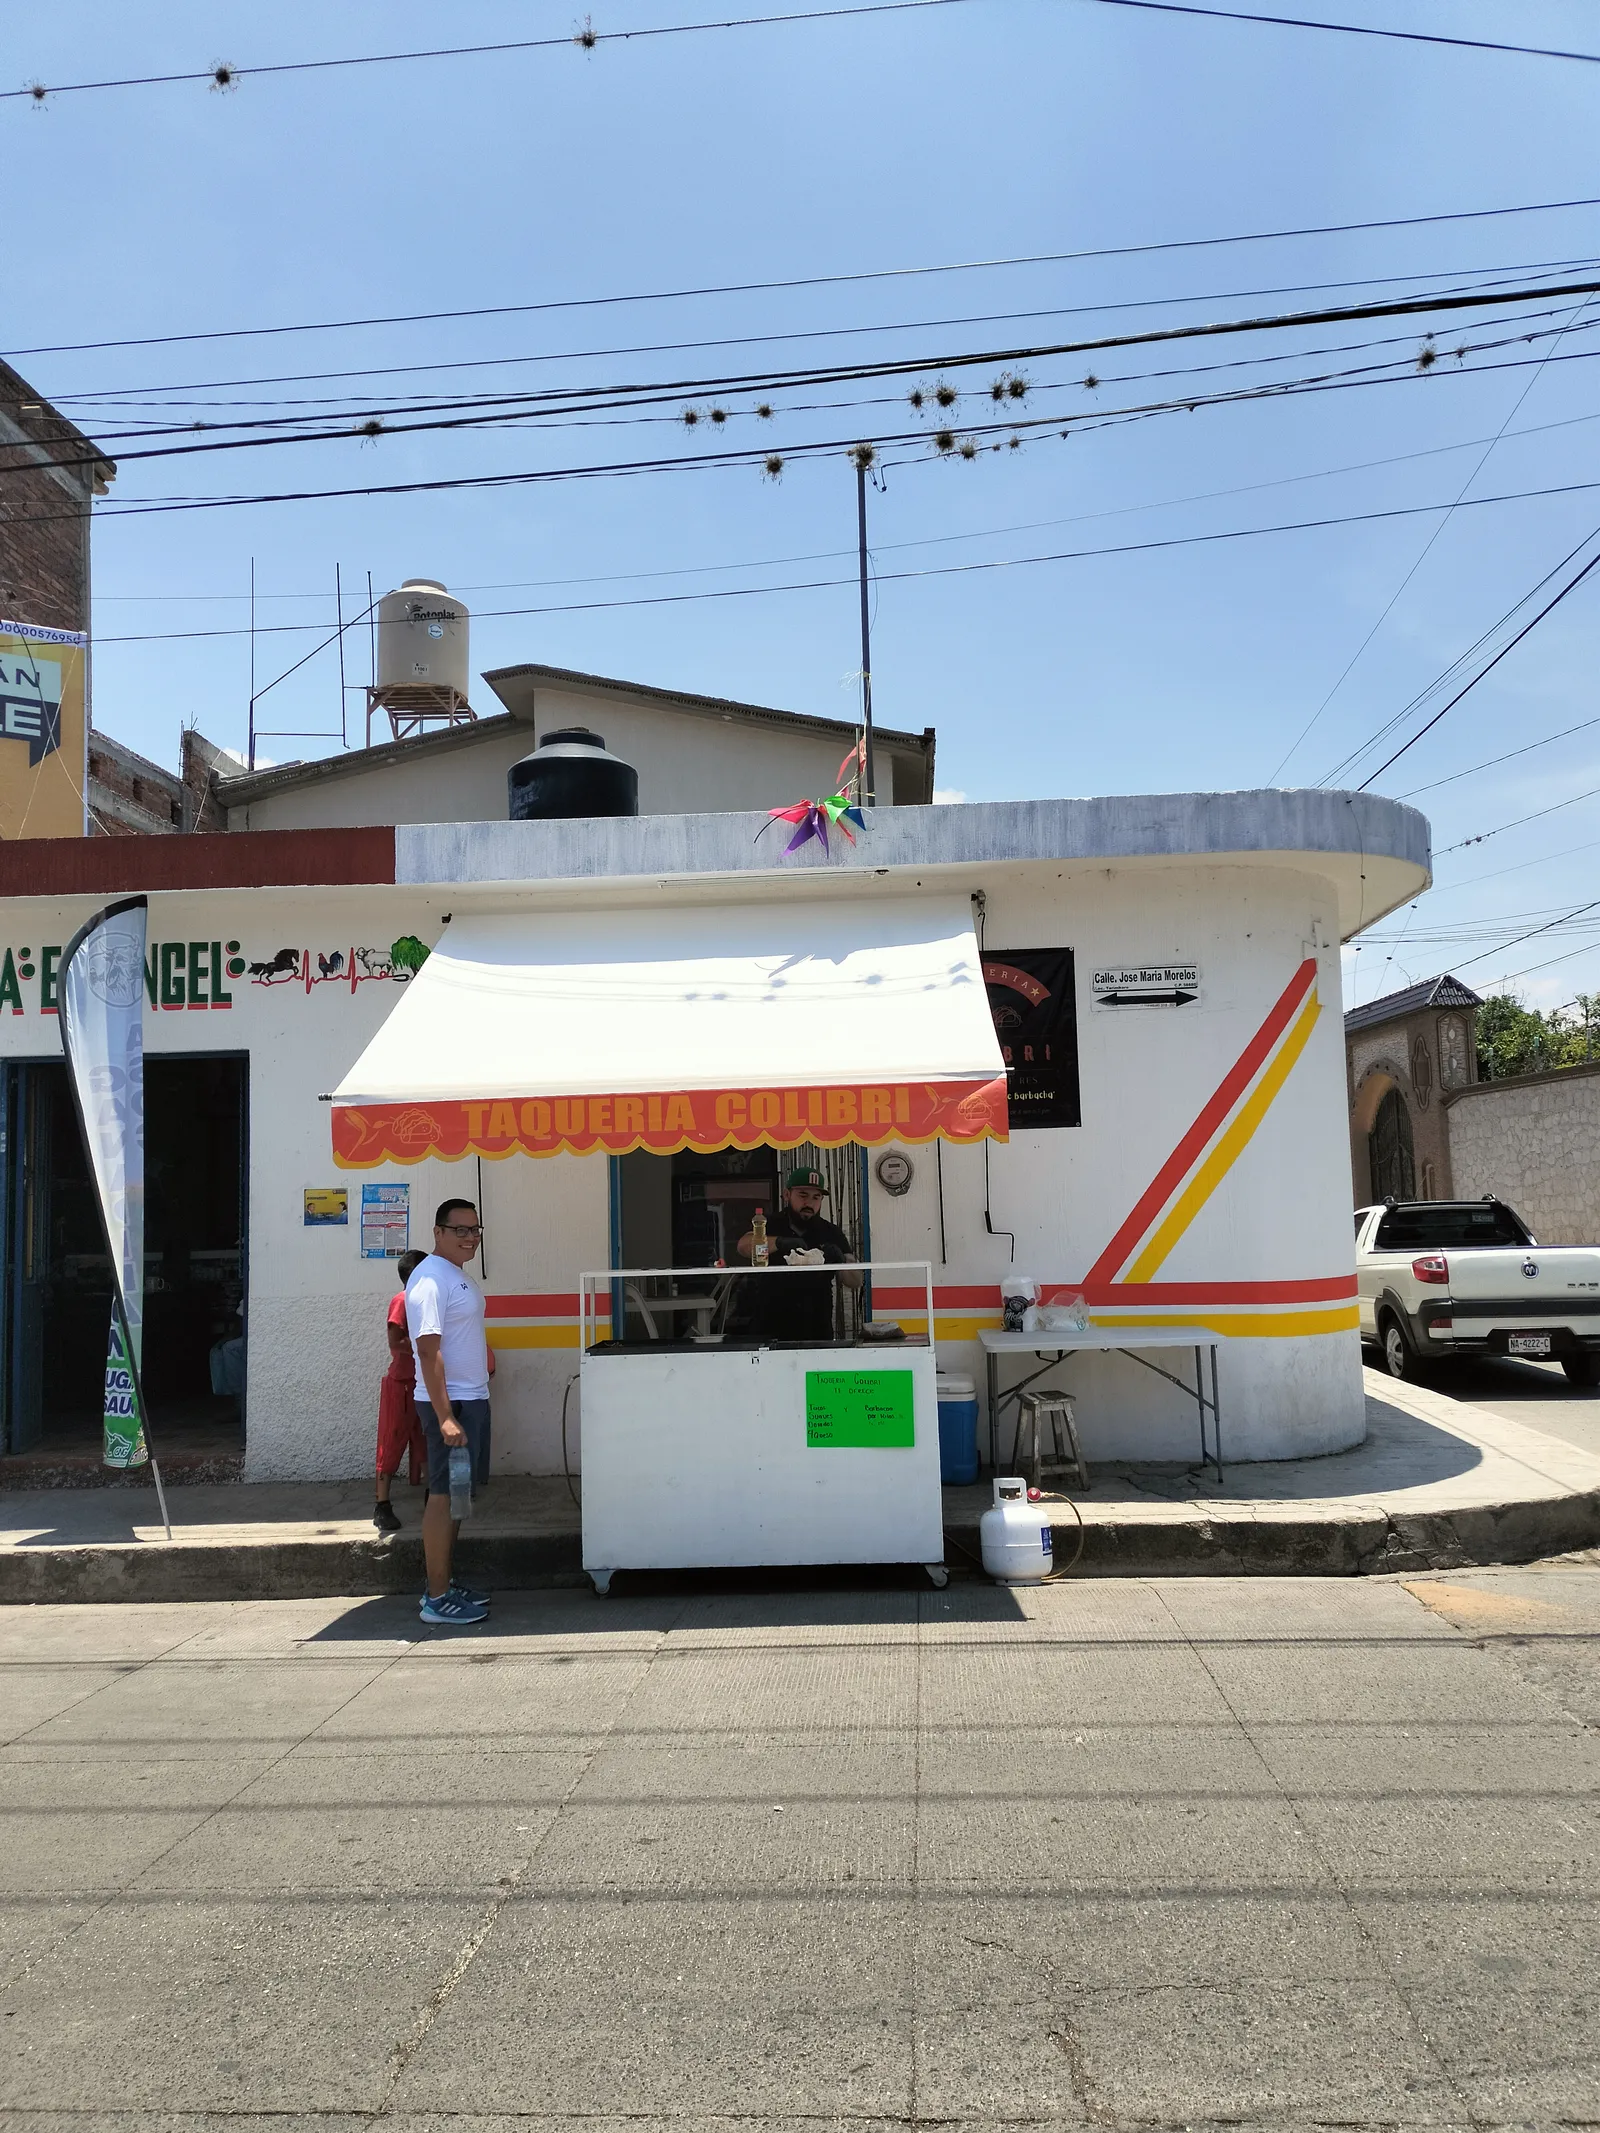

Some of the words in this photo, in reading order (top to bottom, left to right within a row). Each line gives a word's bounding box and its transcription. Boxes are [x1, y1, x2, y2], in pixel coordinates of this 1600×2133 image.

[144, 941, 232, 1011] NGEL
[1119, 972, 1138, 983] Jose
[1140, 970, 1162, 982] Maria
[1164, 969, 1196, 981] Morelos
[461, 1094, 696, 1140] TAQUERIA
[715, 1086, 911, 1129] COLIBRI
[1510, 1339, 1549, 1348] NA-4222-C
